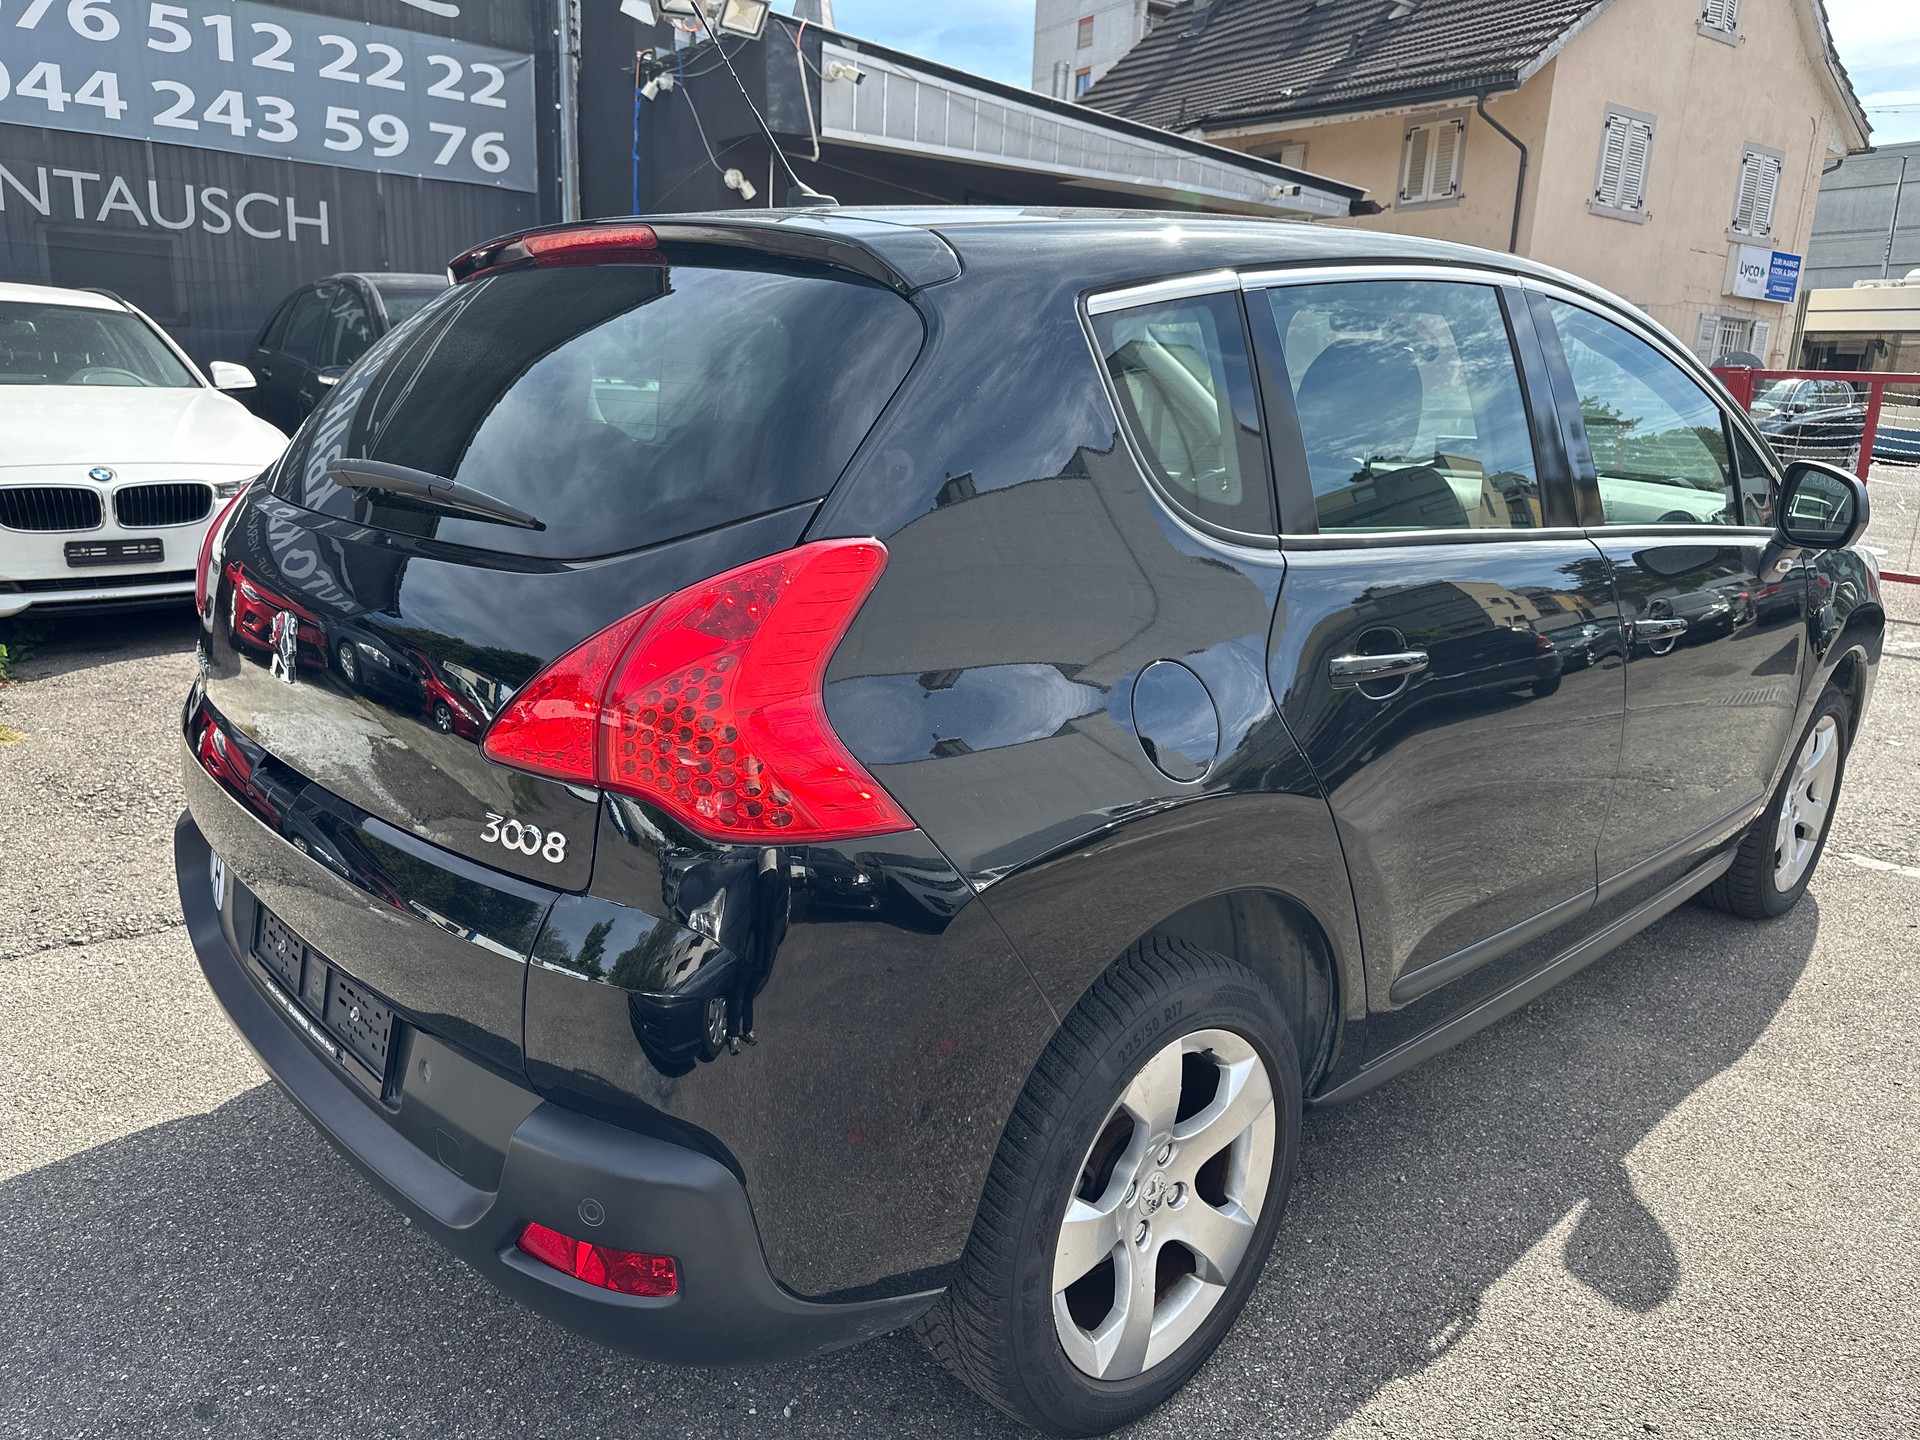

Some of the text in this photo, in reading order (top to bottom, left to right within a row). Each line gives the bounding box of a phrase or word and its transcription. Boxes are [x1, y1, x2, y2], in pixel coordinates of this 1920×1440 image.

[0, 0, 507, 109] 76 512 22 22
[0, 60, 511, 174] 44 243 59 76
[0, 163, 330, 246] NTAUSCH
[1740, 261, 1760, 278] Lyca
[480, 812, 567, 864] 3008
[1118, 999, 1183, 1065] 225/50 R17
